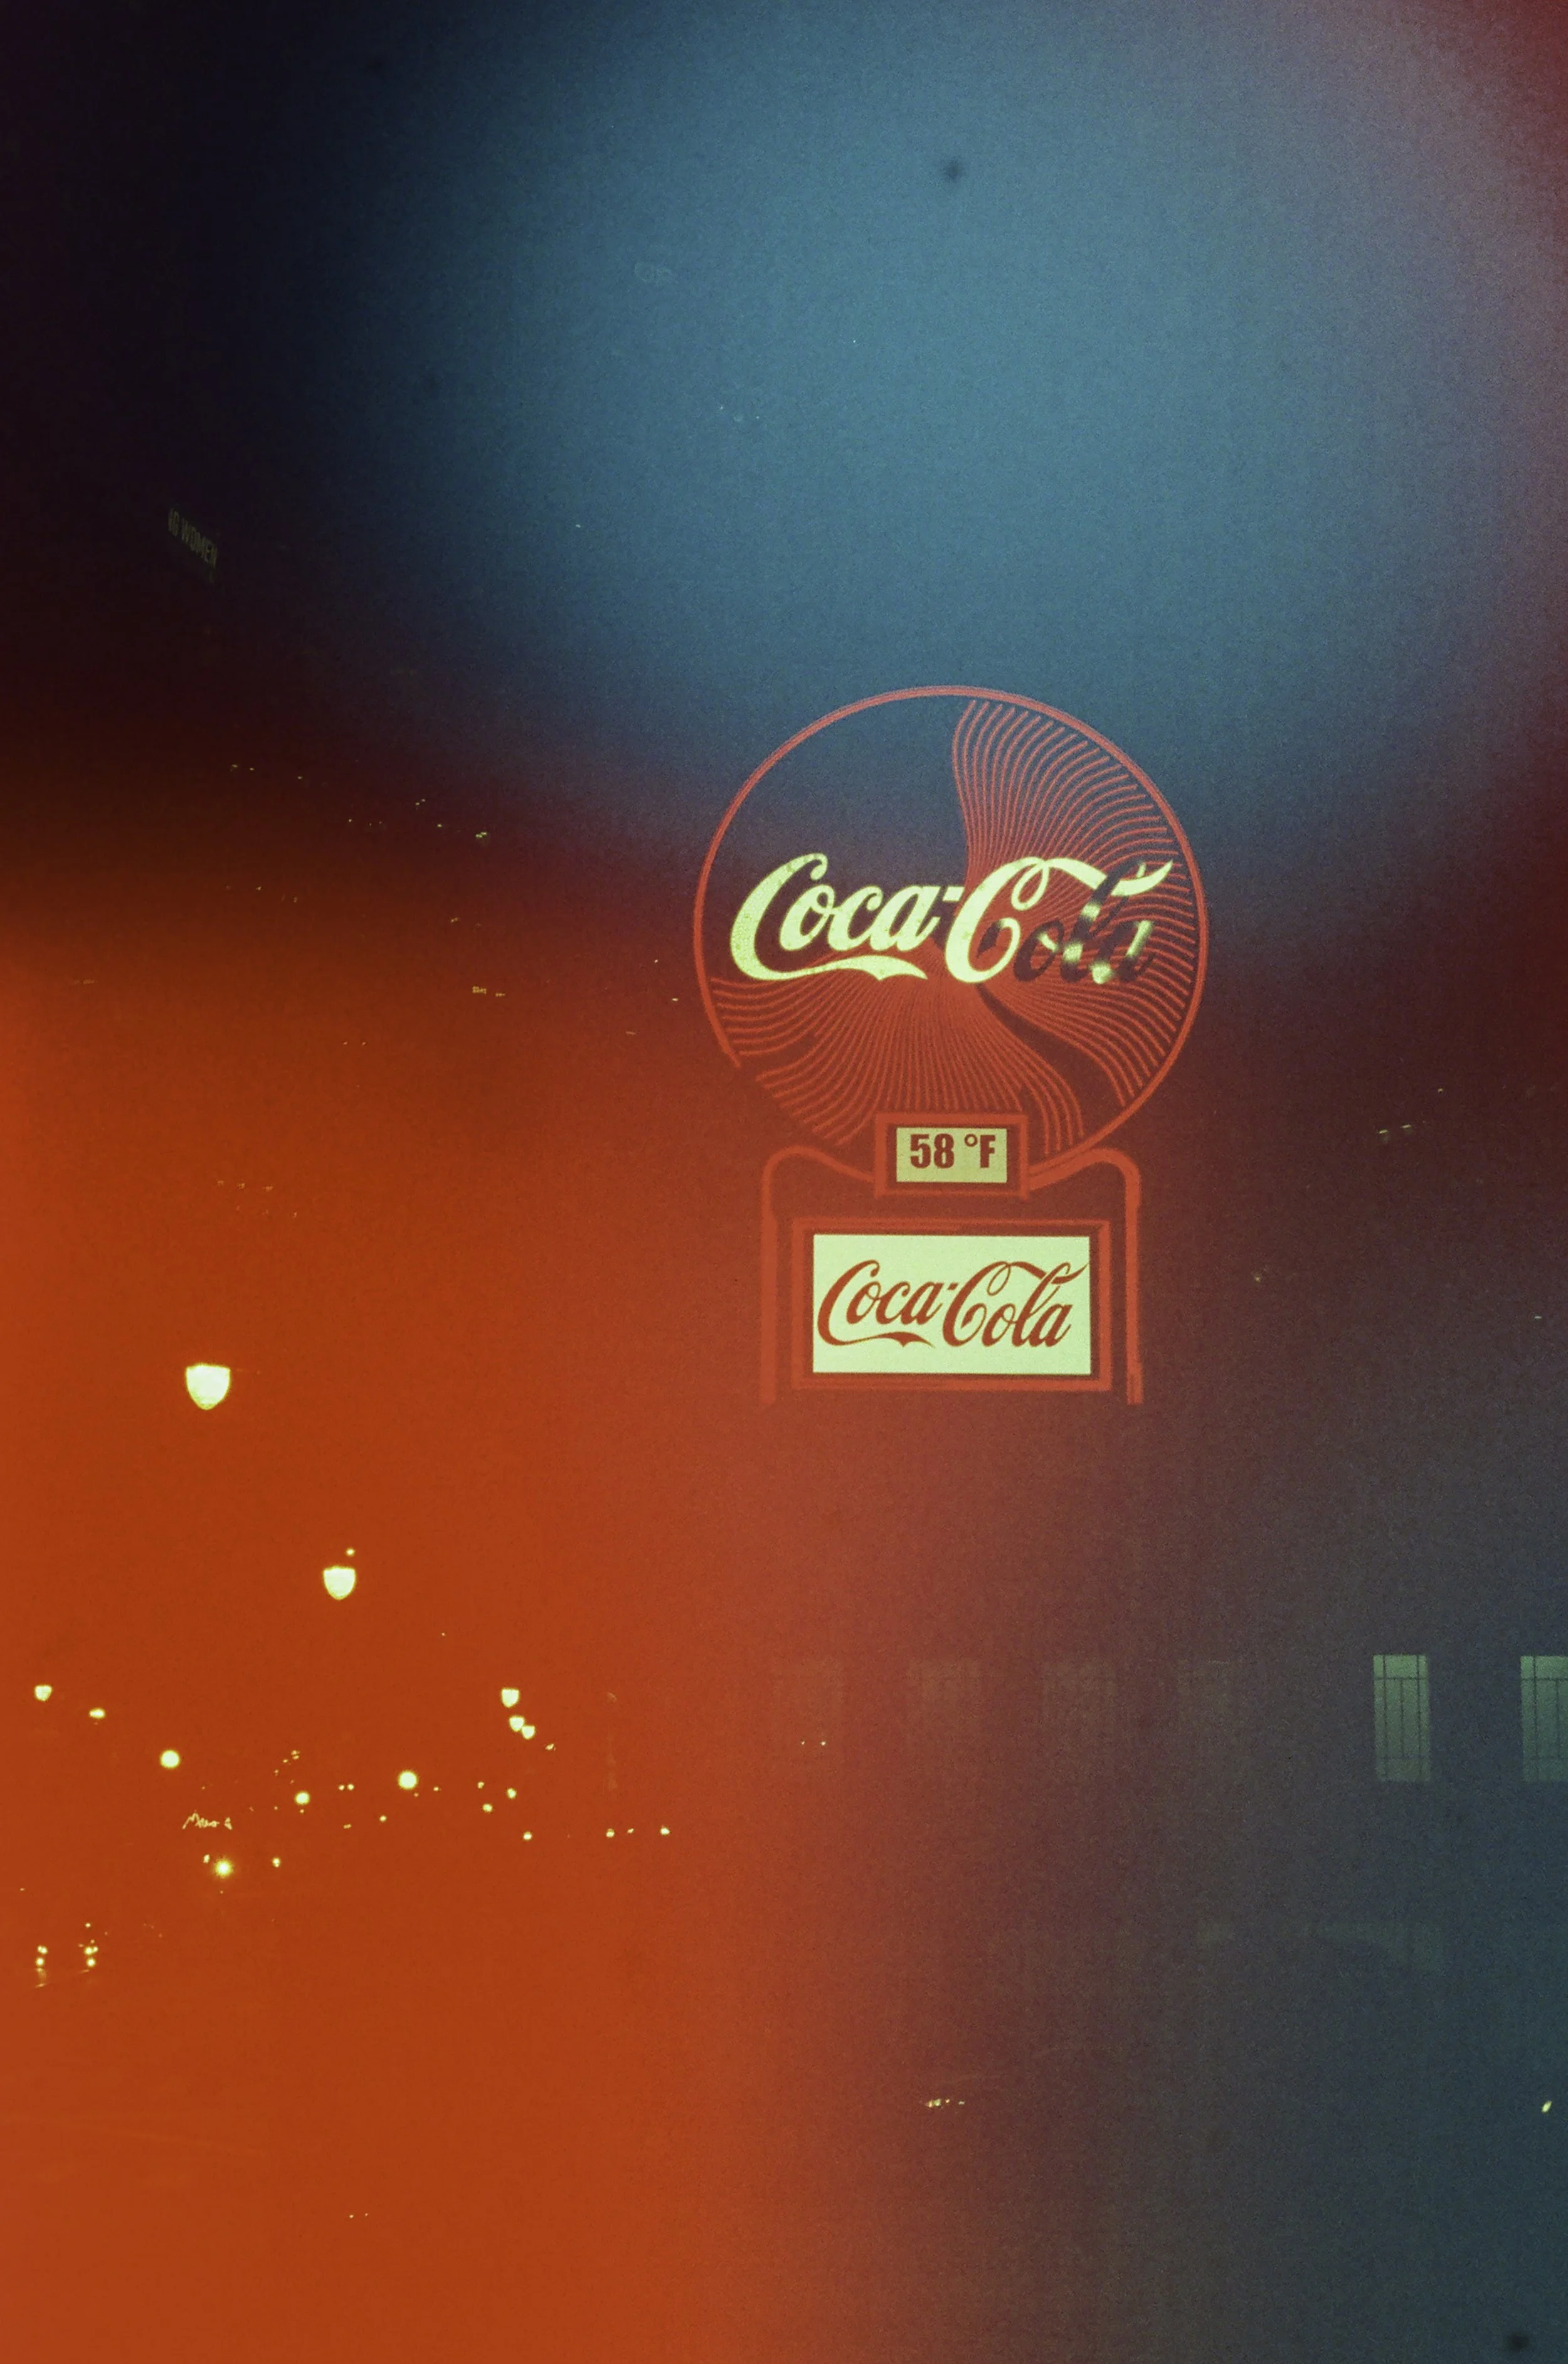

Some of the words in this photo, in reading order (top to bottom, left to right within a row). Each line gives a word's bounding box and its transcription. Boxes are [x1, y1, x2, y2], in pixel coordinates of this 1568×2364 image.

[730, 852, 1173, 983] Coca-Cola
[910, 1133, 954, 1169] 58
[964, 1133, 996, 1169] °F
[817, 1259, 1089, 1348] Coca-Cola
